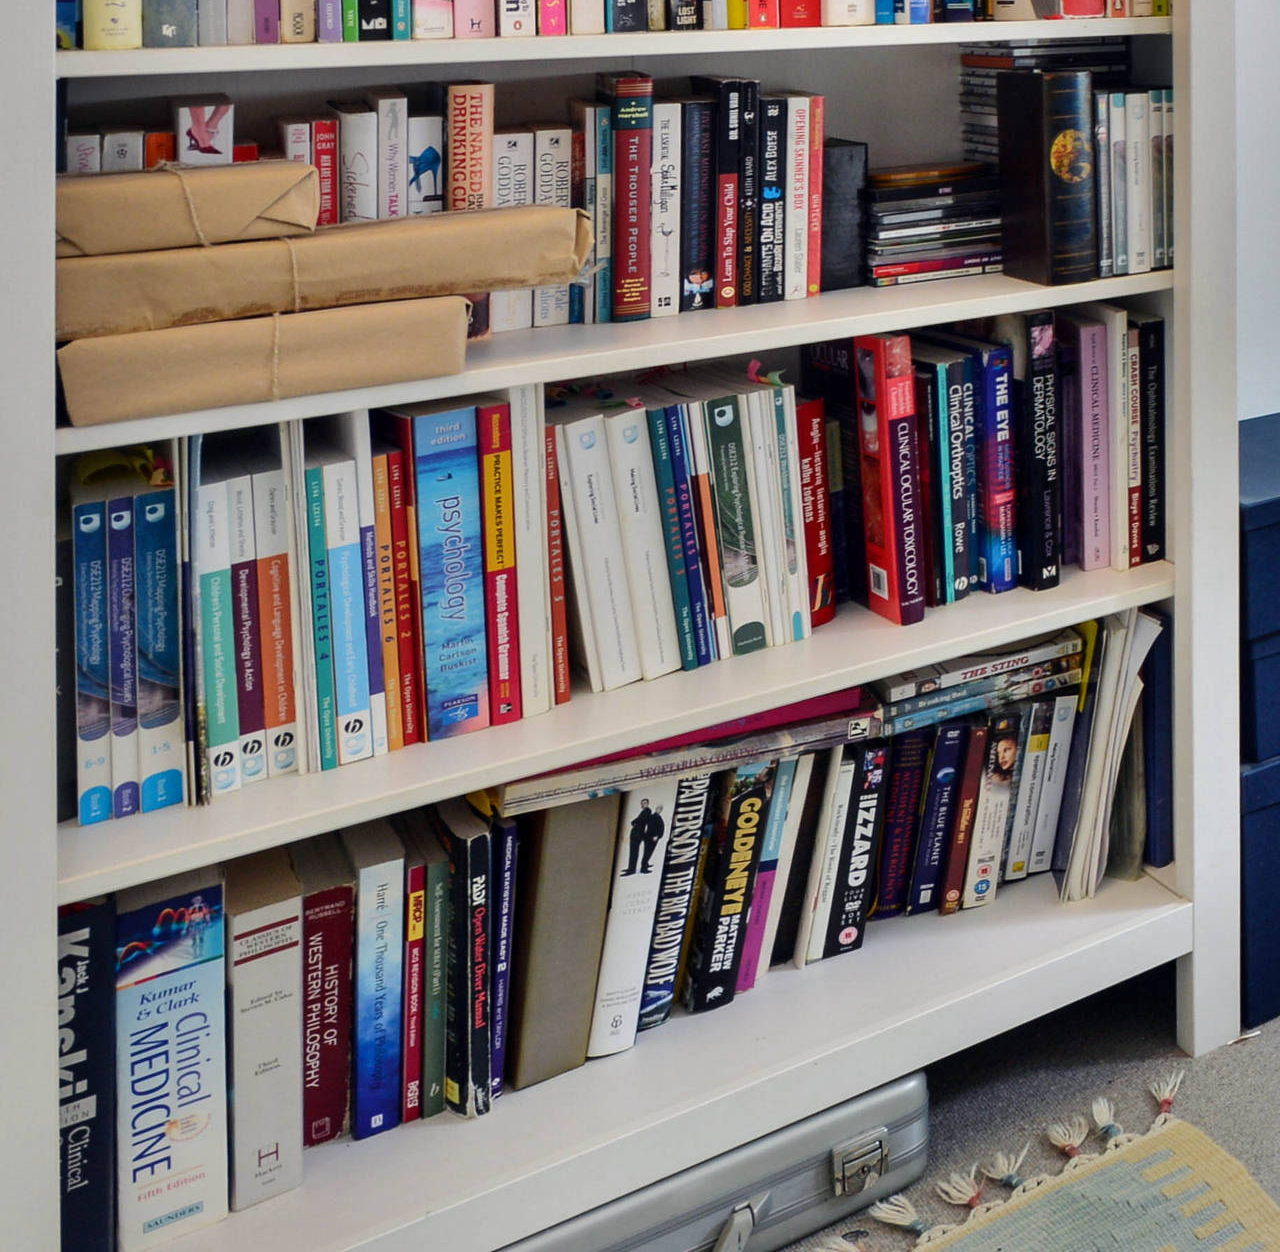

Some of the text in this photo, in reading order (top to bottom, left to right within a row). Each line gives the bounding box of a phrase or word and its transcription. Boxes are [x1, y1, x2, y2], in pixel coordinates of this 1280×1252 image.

[452, 93, 467, 182] DRINKING
[469, 93, 484, 193] THE NAKED
[794, 109, 806, 145] OPENING
[387, 143, 399, 217] Why Women TALK
[628, 136, 639, 273] THE TROUSER PEOPLE
[722, 183, 735, 282] Learn Child
[962, 382, 974, 441] CLINICAL
[995, 372, 1009, 442] THE EYE
[1032, 376, 1045, 461] DERMATOLOGY
[1044, 374, 1057, 481] PHYSICAL SIGNS IN
[1130, 354, 1139, 425] CRASH COURSE
[948, 384, 964, 500] Clinical Orthoptics
[493, 454, 504, 565] PRACTICE MAKES PERFECT
[549, 509, 562, 582] PORTALES
[666, 487, 684, 560] PORTALES
[680, 483, 697, 556] PORTALES
[897, 422, 918, 596] CLINICAL OCULAR TOXICOLOGY
[952, 522, 965, 554] Rowe
[380, 544, 393, 624] PORTALES
[396, 540, 410, 618] PORTALES
[434, 495, 470, 621] psychology
[314, 559, 328, 641] PORTALES
[991, 656, 1029, 672] STING
[720, 797, 762, 916] GOLDENEYE
[930, 786, 951, 866] THE BLUE PLANET
[410, 894, 424, 923] MRCP
[647, 779, 706, 985] PATTERSON BIG BAD WOLF
[374, 944, 388, 991] Thousand
[471, 906, 487, 1029] Open Water Diver Manual
[708, 916, 730, 973] PARKER
[723, 915, 741, 971] MATTHEW
[140, 979, 197, 1007] Kumar
[155, 992, 200, 1016] Clark
[304, 932, 324, 1089] WESTERN PHILOSOPHY
[323, 964, 339, 1046] HISTORY OF
[175, 1011, 212, 1108] Clinical
[129, 1021, 172, 1184] MEDICINE
[67, 1125, 90, 1193] Clinical
[166, 1170, 206, 1190] Edition
